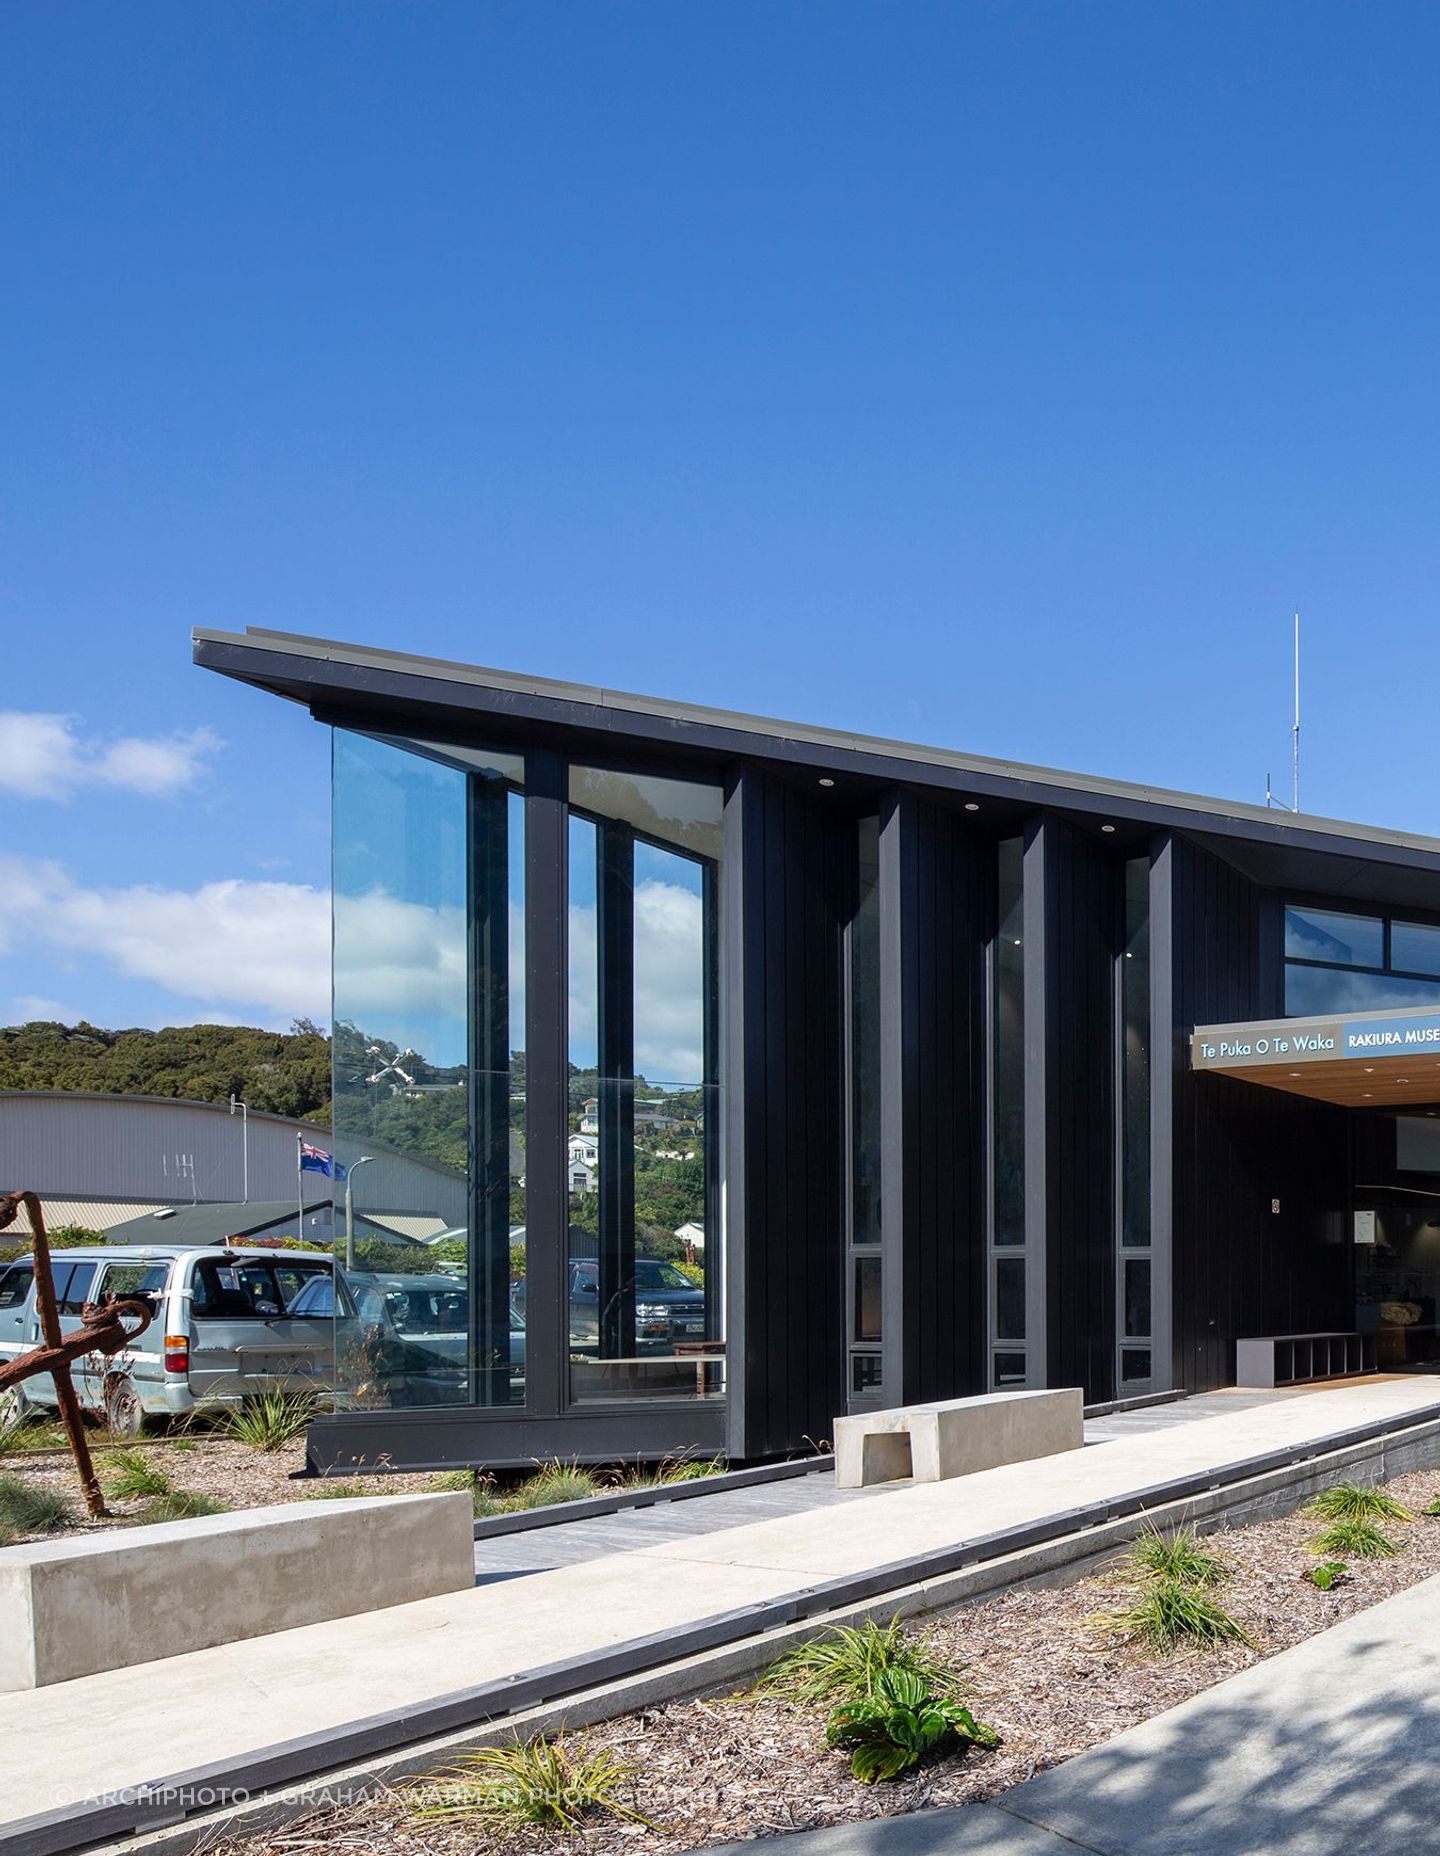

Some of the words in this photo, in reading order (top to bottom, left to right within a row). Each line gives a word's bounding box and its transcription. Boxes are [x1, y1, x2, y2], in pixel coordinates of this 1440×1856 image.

[1201, 1043, 1216, 1058] Te
[1220, 1040, 1251, 1057] Puka
[1256, 1039, 1269, 1054] O
[1273, 1038, 1289, 1053] Te
[1293, 1033, 1335, 1051] Waka
[1348, 1031, 1402, 1048] RAKIURA
